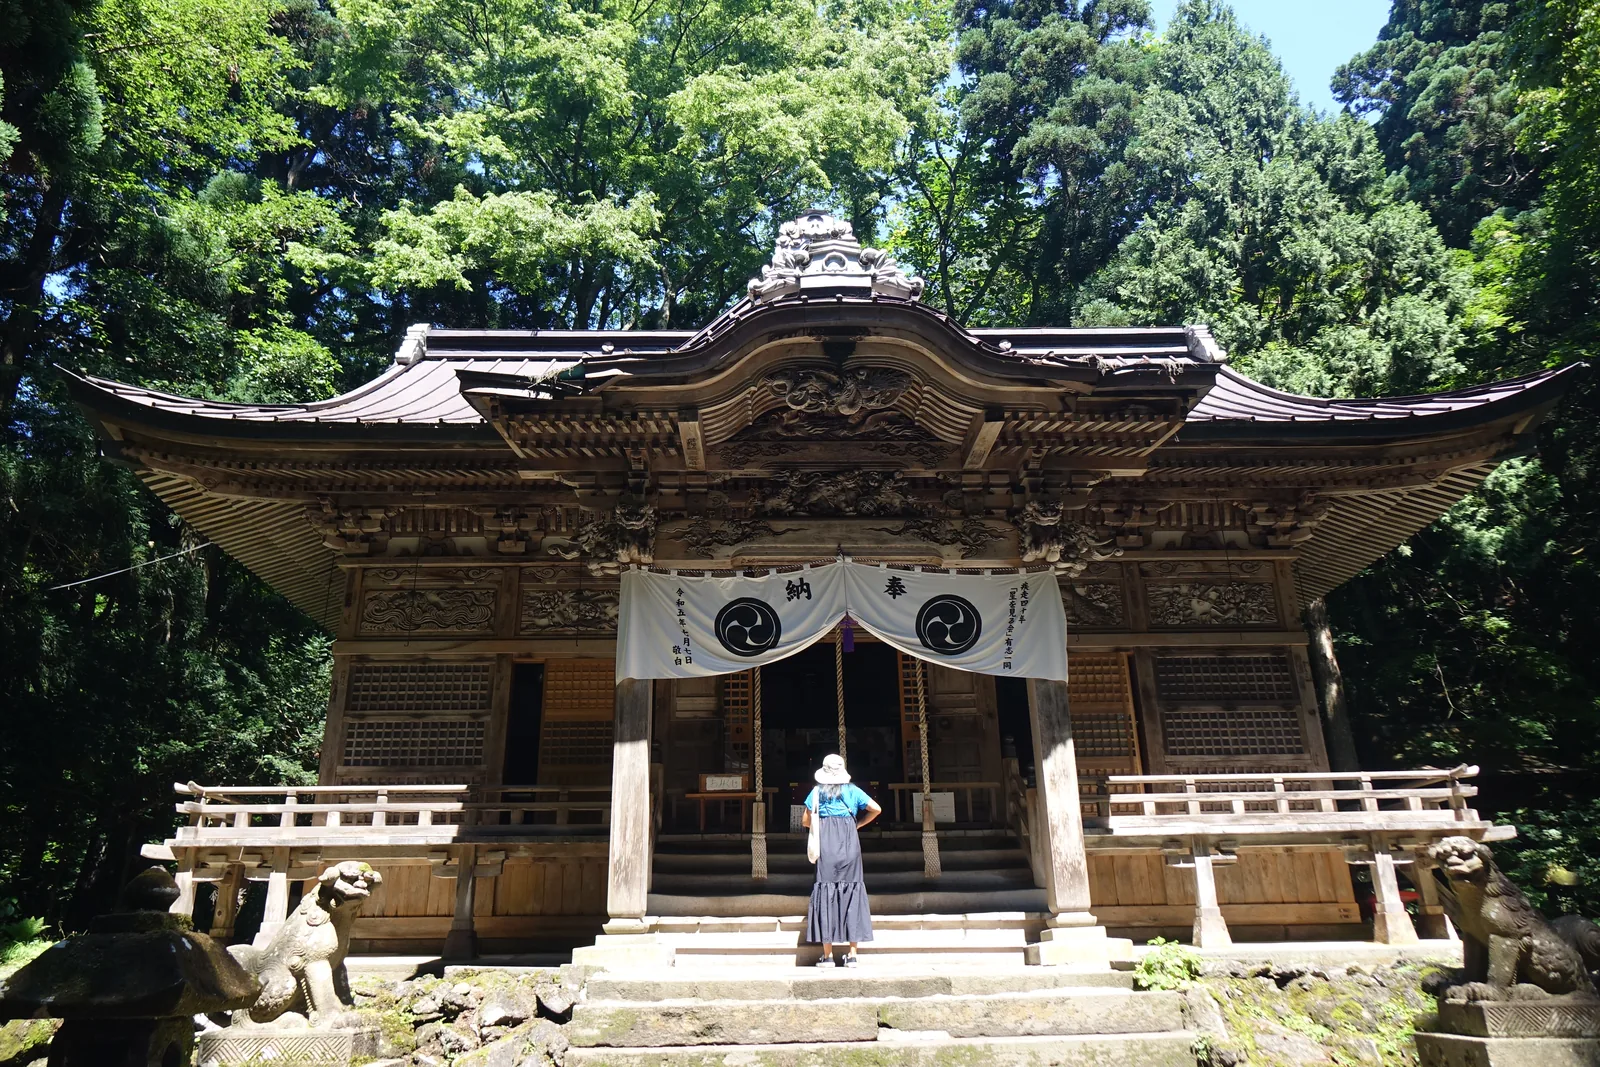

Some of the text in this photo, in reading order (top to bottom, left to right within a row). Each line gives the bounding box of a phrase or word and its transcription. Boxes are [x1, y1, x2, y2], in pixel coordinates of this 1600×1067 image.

[785, 575, 908, 602] 奉 納
[675, 587, 693, 665] 令和五年七月七日
[672, 645, 682, 666] 敬白
